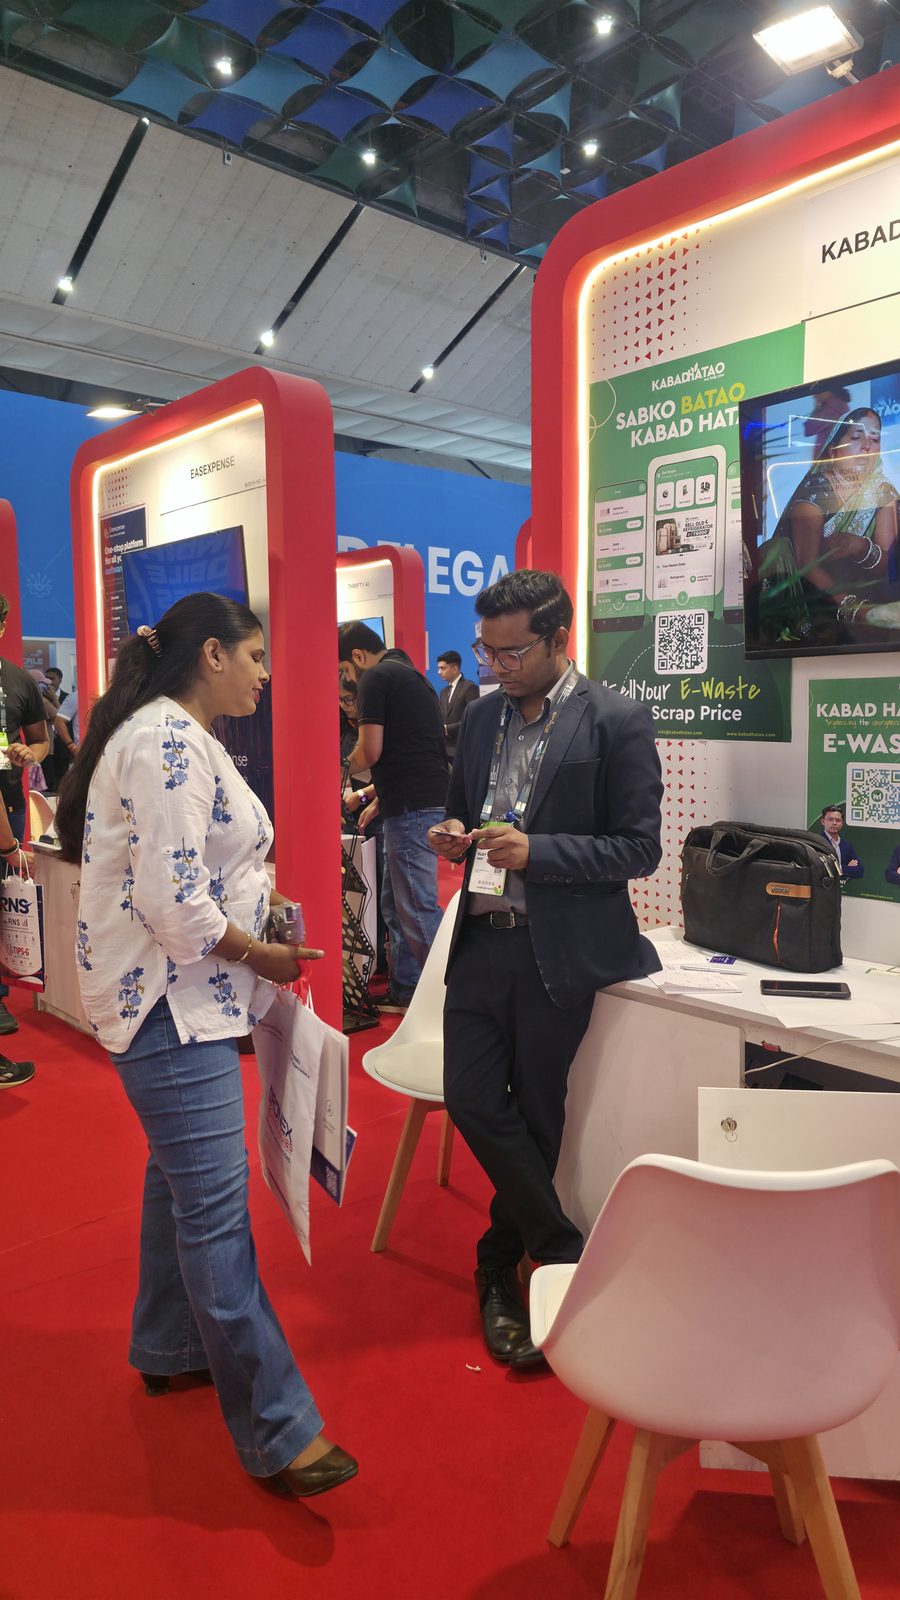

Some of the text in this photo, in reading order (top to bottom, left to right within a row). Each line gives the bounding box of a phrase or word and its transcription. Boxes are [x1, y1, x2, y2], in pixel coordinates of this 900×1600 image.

[615, 382, 745, 430] SABKO BATAO
[631, 406, 739, 448] KABAD HAT
[190, 456, 235, 479] EASEXPENSE
[681, 675, 760, 700] E-Waste
[651, 703, 742, 724] Scrap Price
[816, 702, 877, 717] KABAD
[0, 896, 31, 914] RNS
